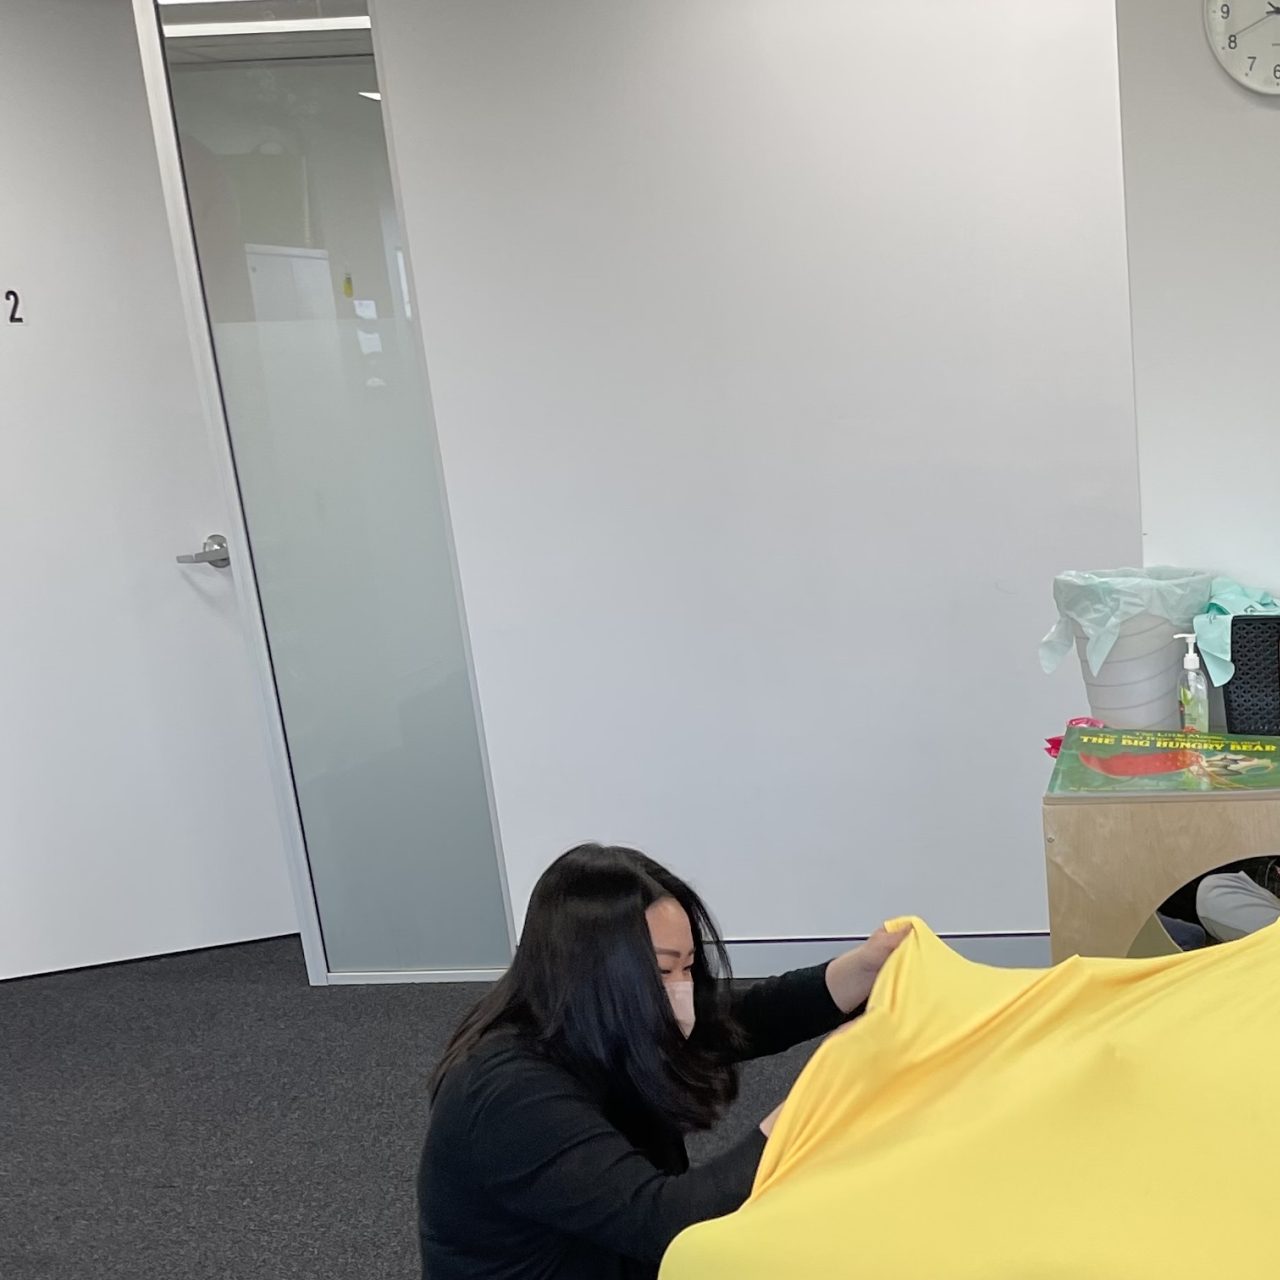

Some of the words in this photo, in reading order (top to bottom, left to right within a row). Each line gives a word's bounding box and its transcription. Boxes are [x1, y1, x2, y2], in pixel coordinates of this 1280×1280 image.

[1220, 4, 1230, 19] 9
[1228, 34, 1238, 50] 8
[1247, 56, 1257, 71] 7
[5, 290, 23, 323] 2
[1080, 736, 1115, 745] THE
[1121, 738, 1151, 748] BIG
[1155, 740, 1225, 751] HUNGRY
[1230, 743, 1277, 752] BEAR
